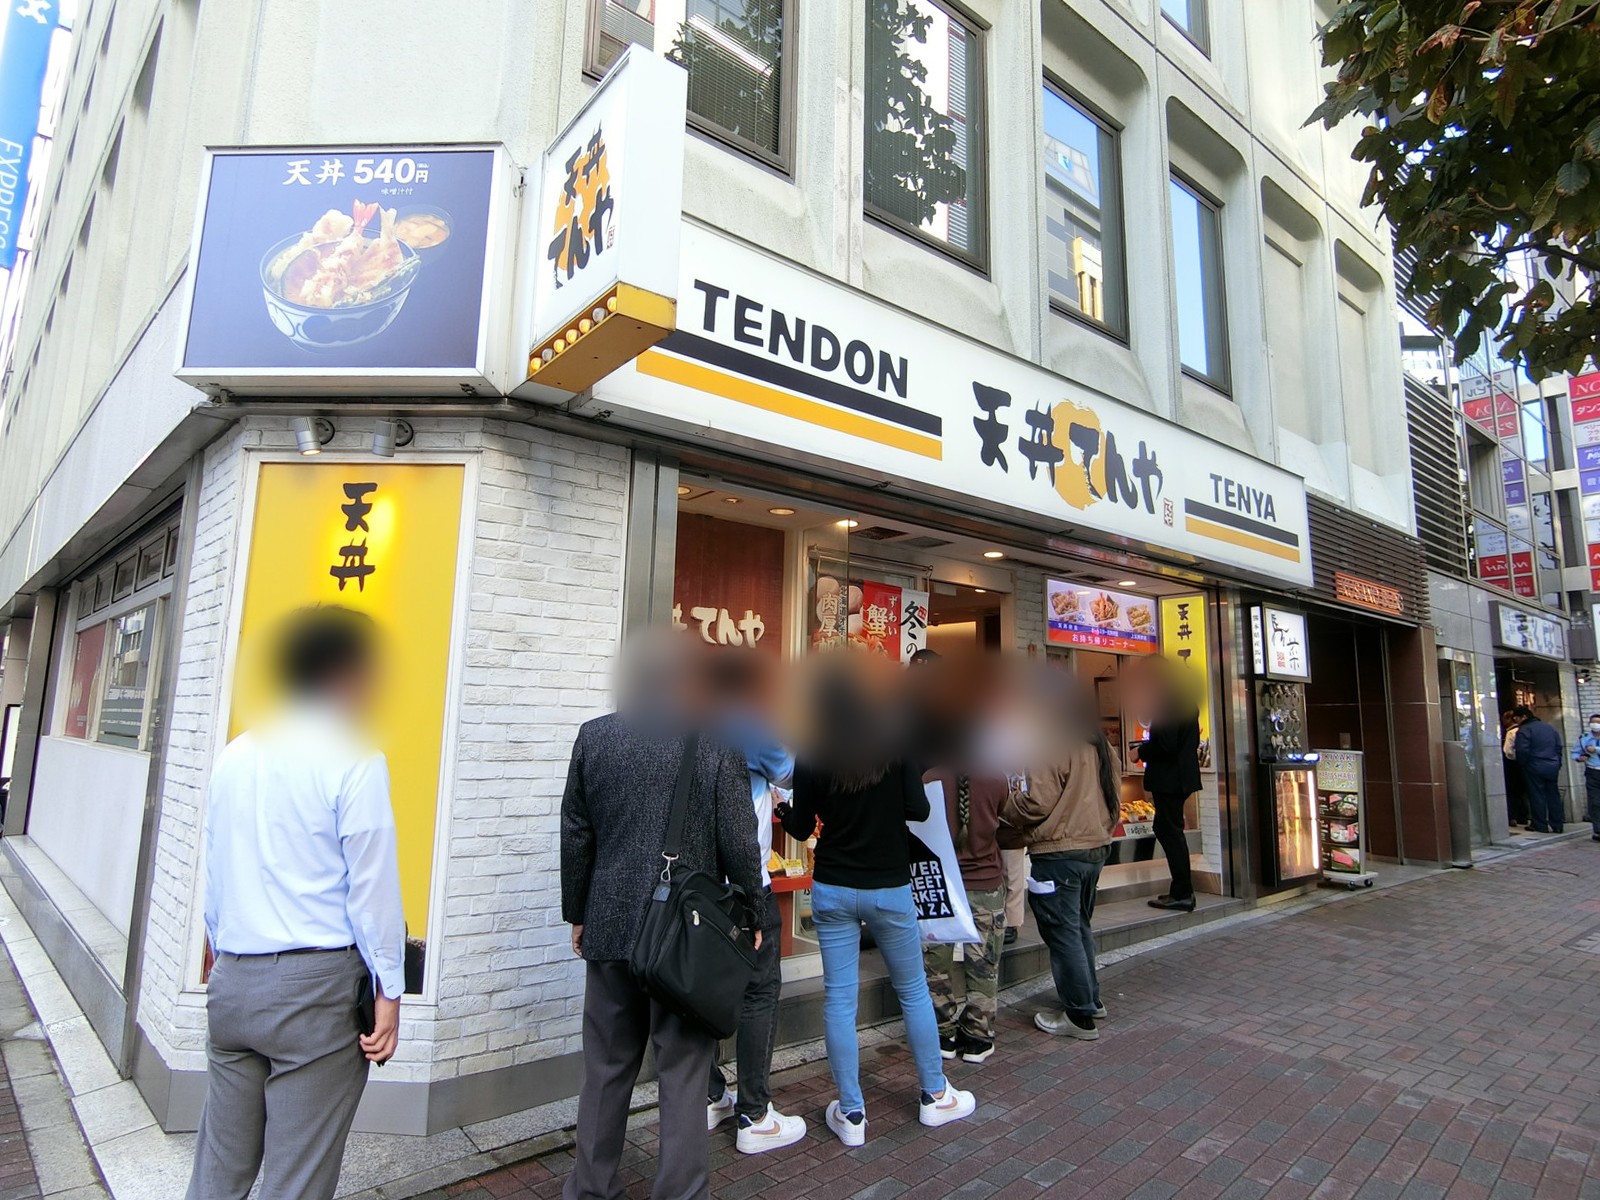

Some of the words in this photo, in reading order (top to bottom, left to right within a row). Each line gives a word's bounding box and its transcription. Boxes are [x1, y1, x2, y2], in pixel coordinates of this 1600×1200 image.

[282, 158, 346, 186] 天丼
[564, 119, 606, 207] 天丼
[547, 185, 614, 290] てんや
[694, 279, 909, 399] TENDON
[1210, 473, 1277, 523] TENYA
[329, 482, 378, 593] 天丼
[866, 603, 888, 638] 蟹
[888, 596, 898, 636] ずわい
[900, 600, 928, 655] 冬の
[1072, 633, 1136, 649] お持ち帰りコーナー
